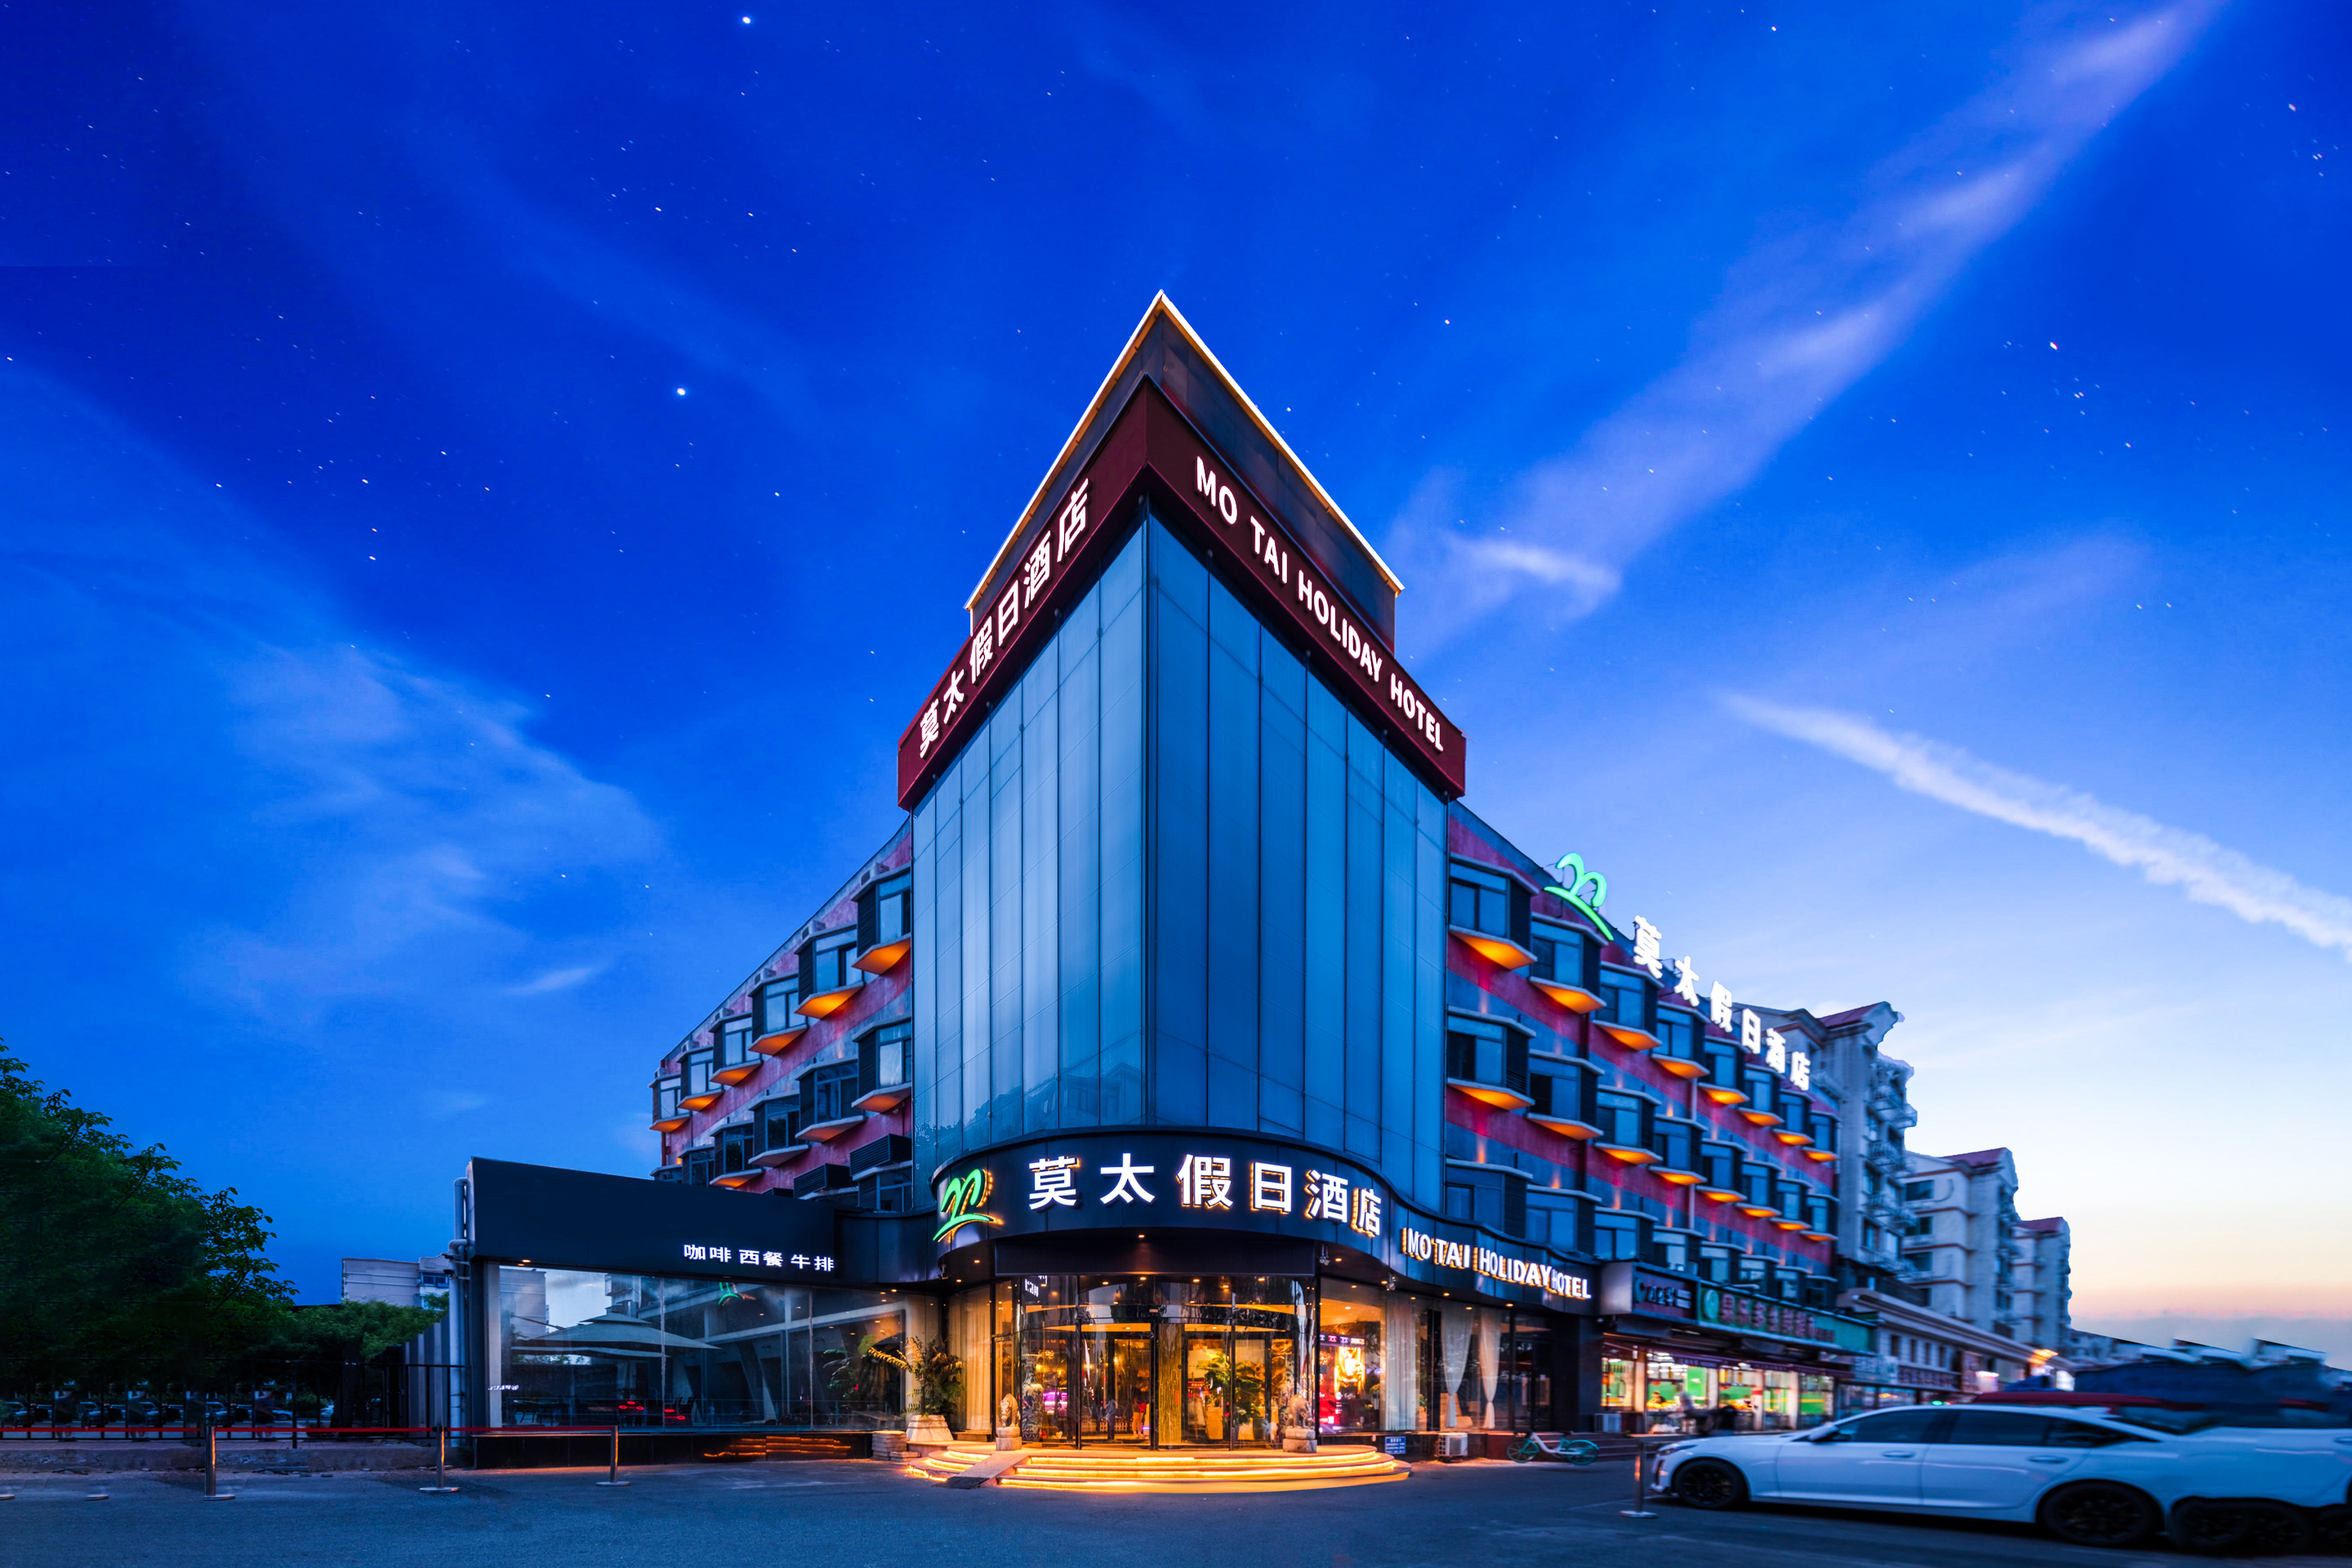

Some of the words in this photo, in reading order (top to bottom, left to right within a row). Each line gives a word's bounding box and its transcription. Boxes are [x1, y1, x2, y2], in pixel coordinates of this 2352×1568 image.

[919, 477, 1089, 760] 莫太假日酒店
[1196, 455, 1238, 525] MO
[1250, 514, 1289, 585] TAI
[1298, 568, 1383, 683] HOLIDAY
[1390, 672, 1445, 752] HOTEL
[1633, 914, 1811, 1091] 莫太假日酒店
[683, 1243, 733, 1263] 咖啡
[737, 1249, 784, 1268] 西餐
[790, 1253, 835, 1272] 牛排
[1028, 1152, 1383, 1238] 莫太假日酒店
[1406, 1227, 1432, 1260] MO
[1433, 1237, 1471, 1269] TAI
[1478, 1246, 1552, 1287] HOLIDAY
[1552, 1268, 1592, 1299] HOTEL
